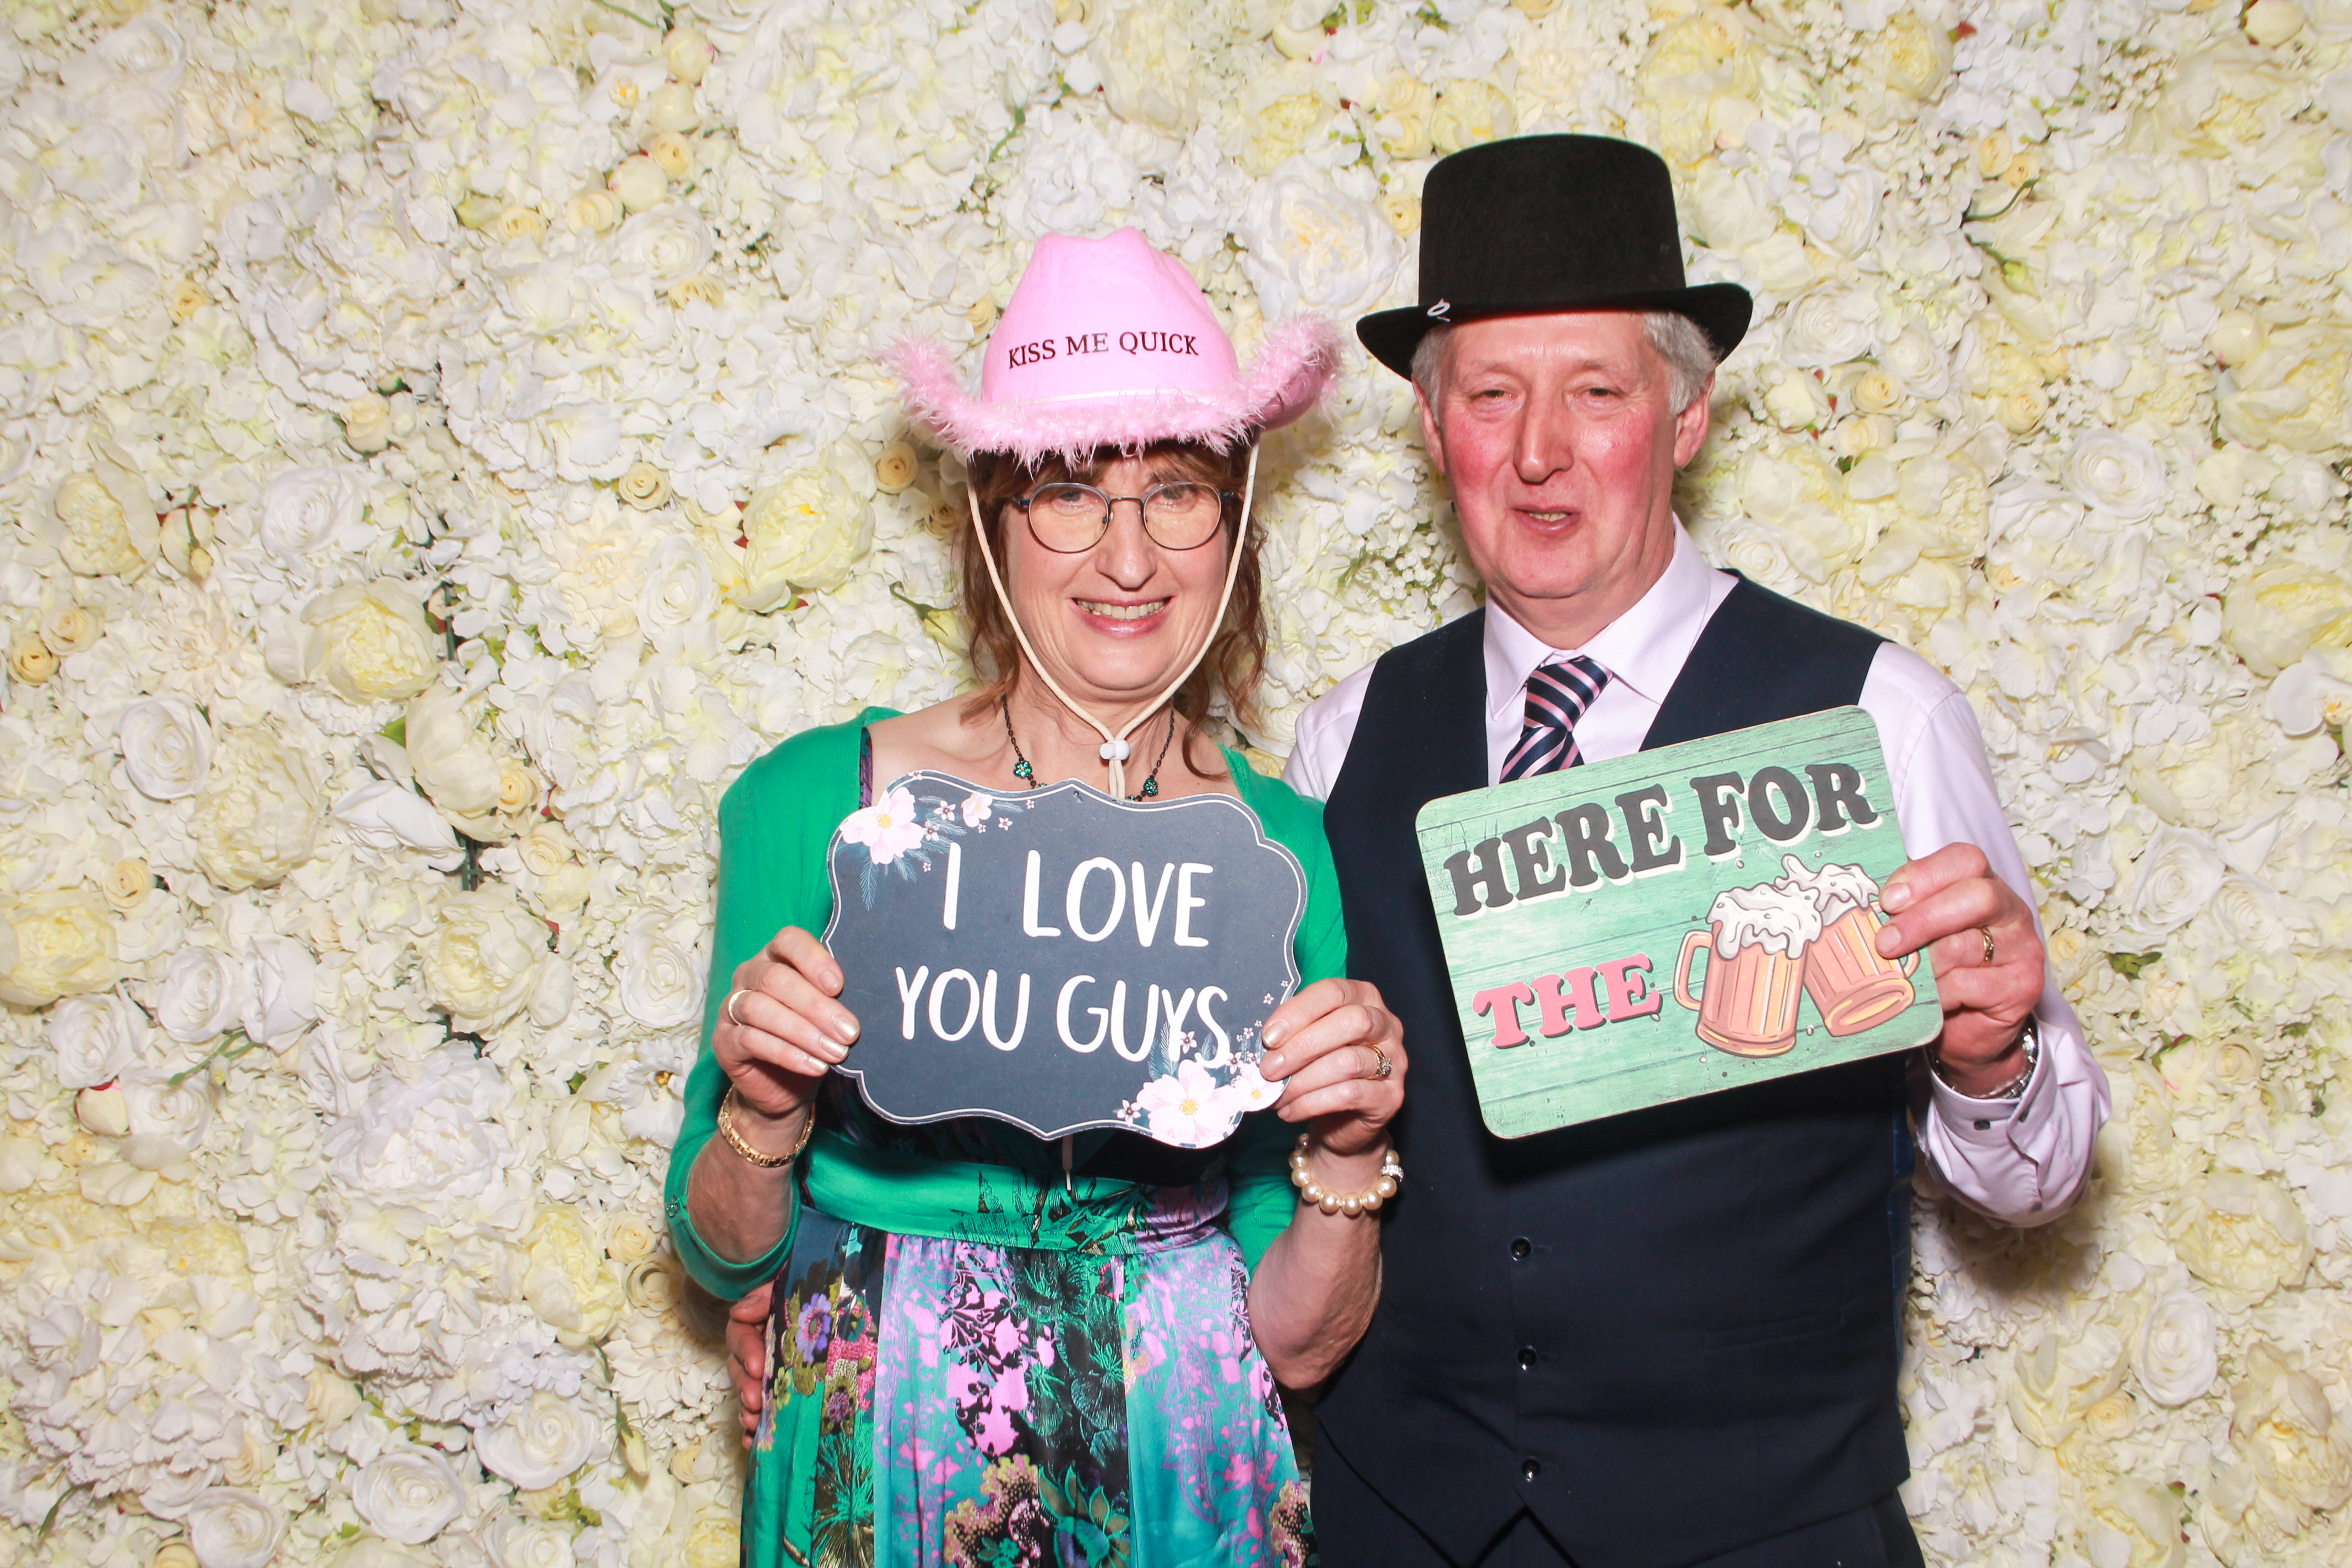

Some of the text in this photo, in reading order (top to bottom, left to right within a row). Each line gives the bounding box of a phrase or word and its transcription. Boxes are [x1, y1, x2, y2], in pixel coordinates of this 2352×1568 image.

[1009, 331, 1199, 369] KISS ME QUICK
[1443, 763, 1881, 918] HERE FOR
[943, 842, 1213, 947] I LOVE
[895, 965, 1231, 1069] YOU GUYS
[1472, 952, 1663, 1049] THE
